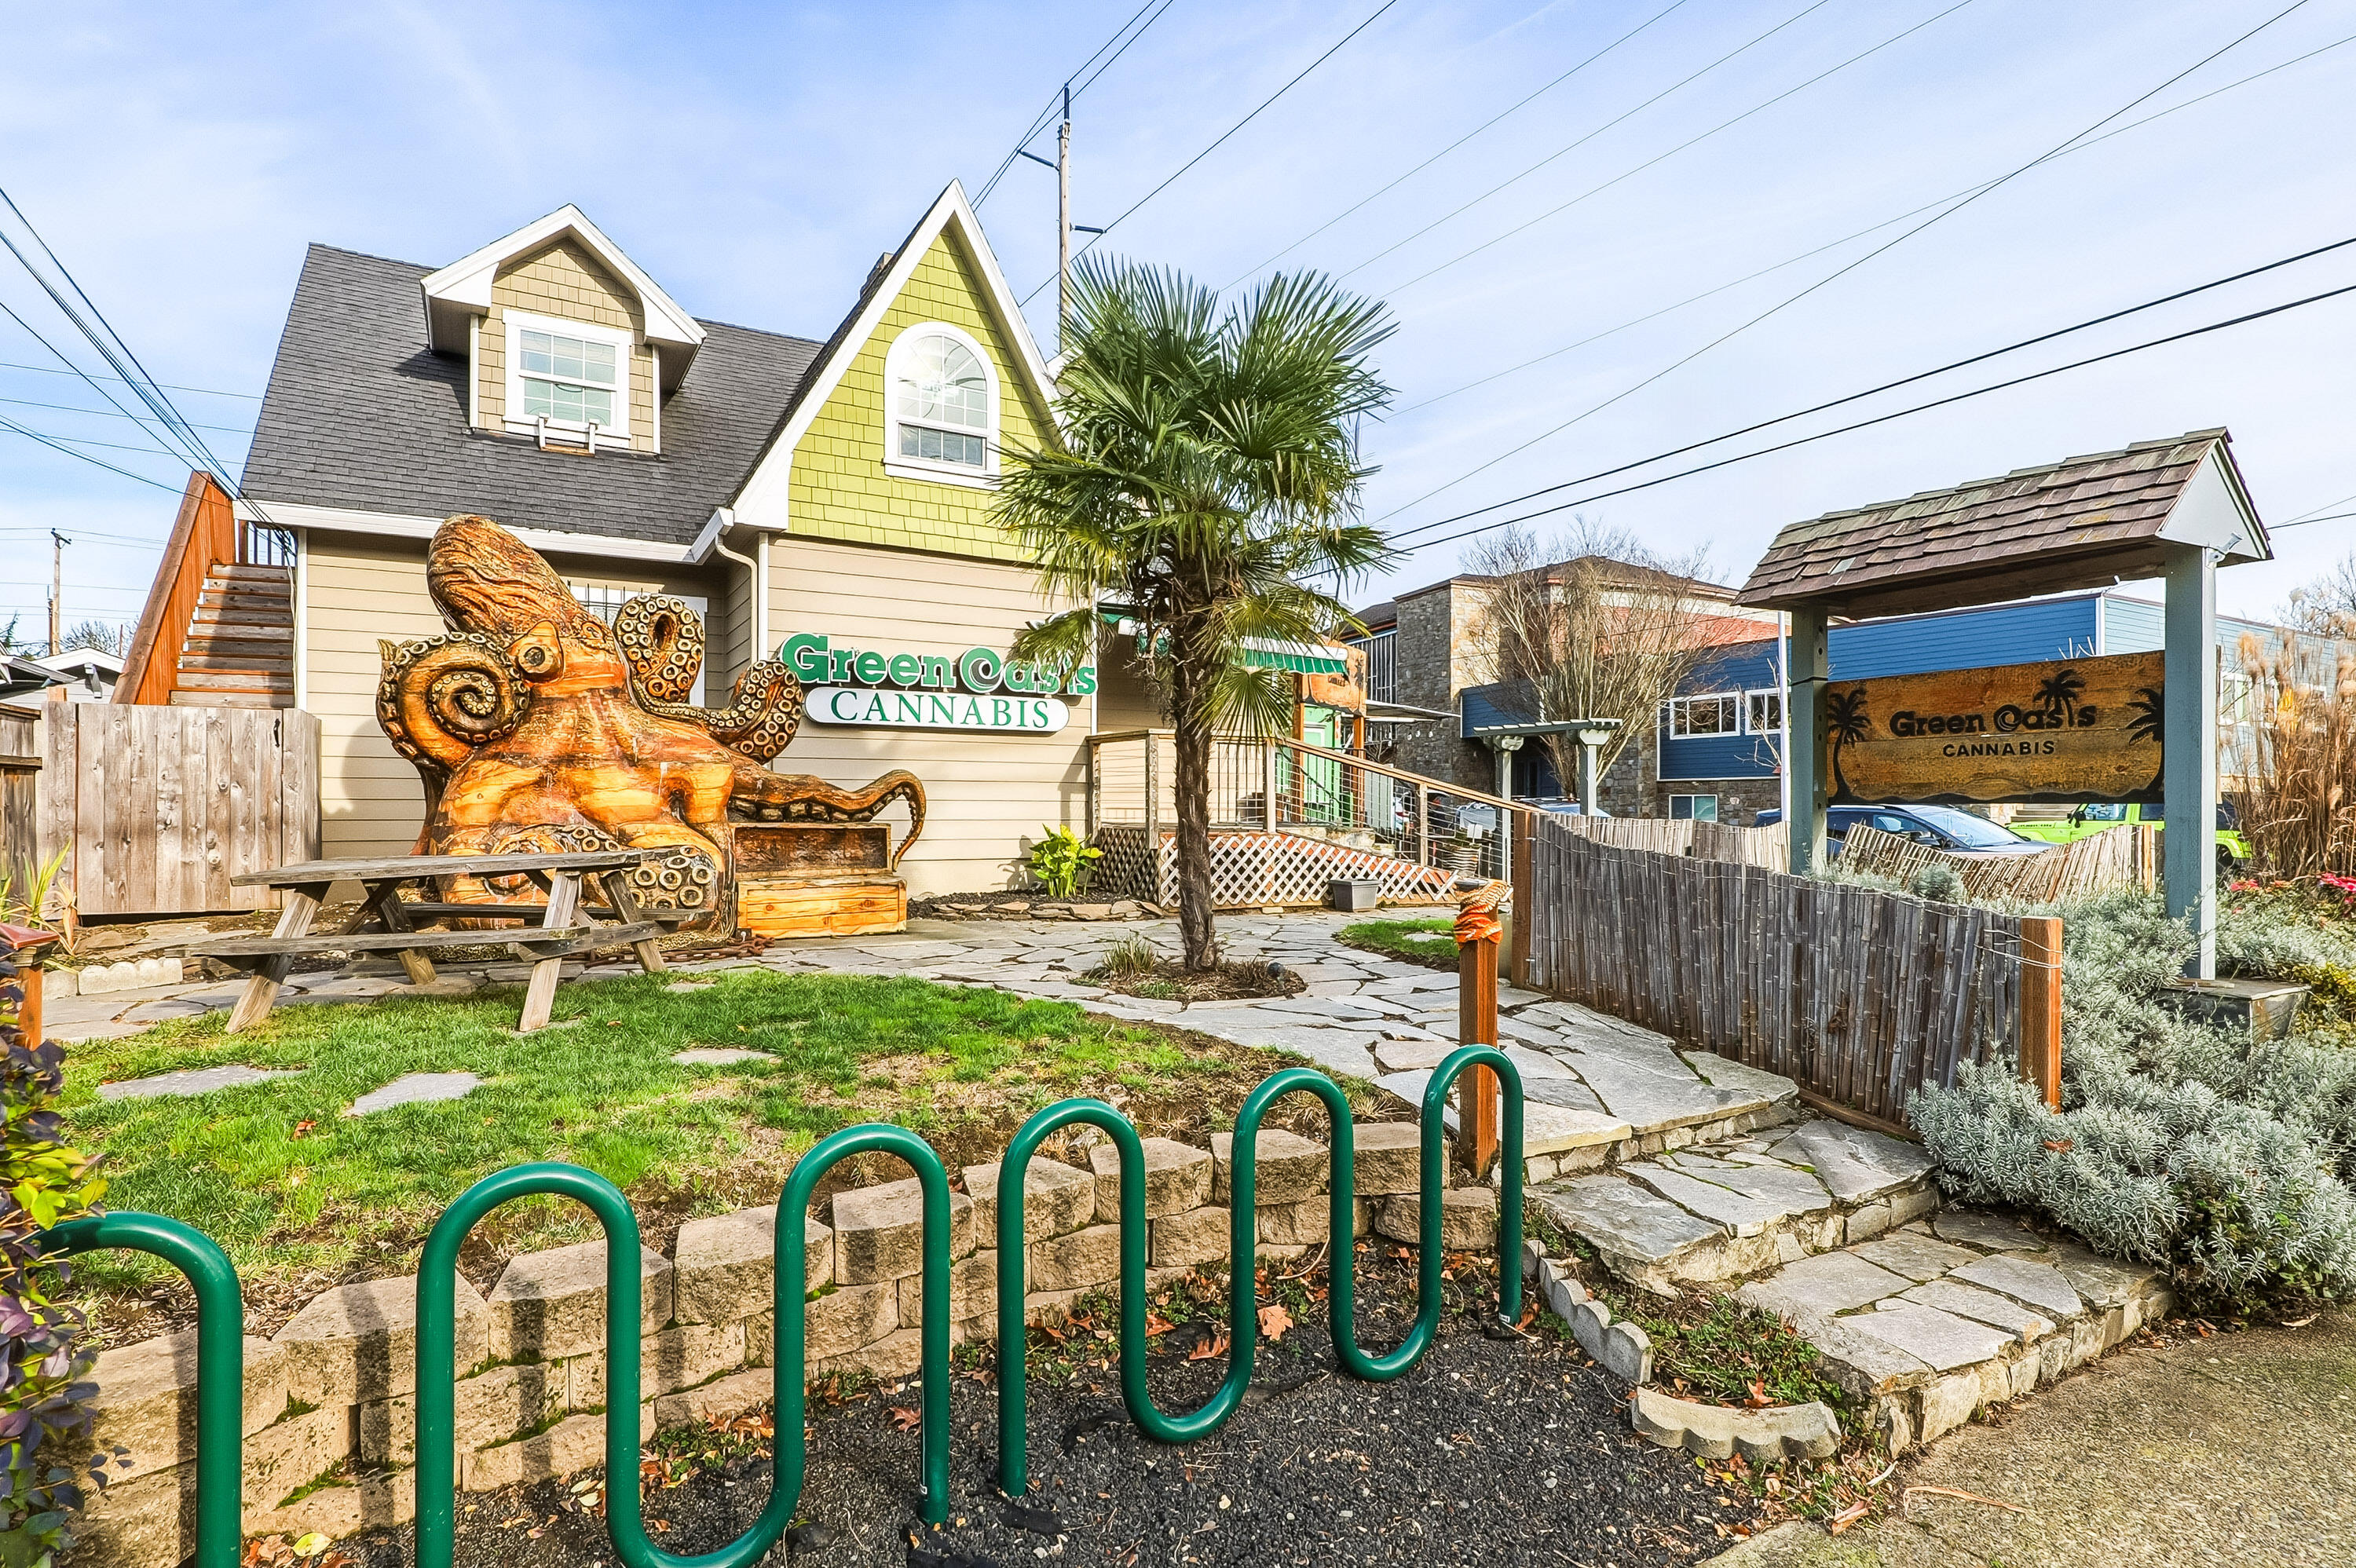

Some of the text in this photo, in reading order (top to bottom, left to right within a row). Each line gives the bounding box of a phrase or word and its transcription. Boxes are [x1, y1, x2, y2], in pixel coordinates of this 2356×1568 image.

[781, 633, 956, 688] Green
[831, 691, 1048, 728] CANNABIS
[1890, 704, 2097, 736] Green Oasis
[1943, 740, 2055, 757] CANNABIS
